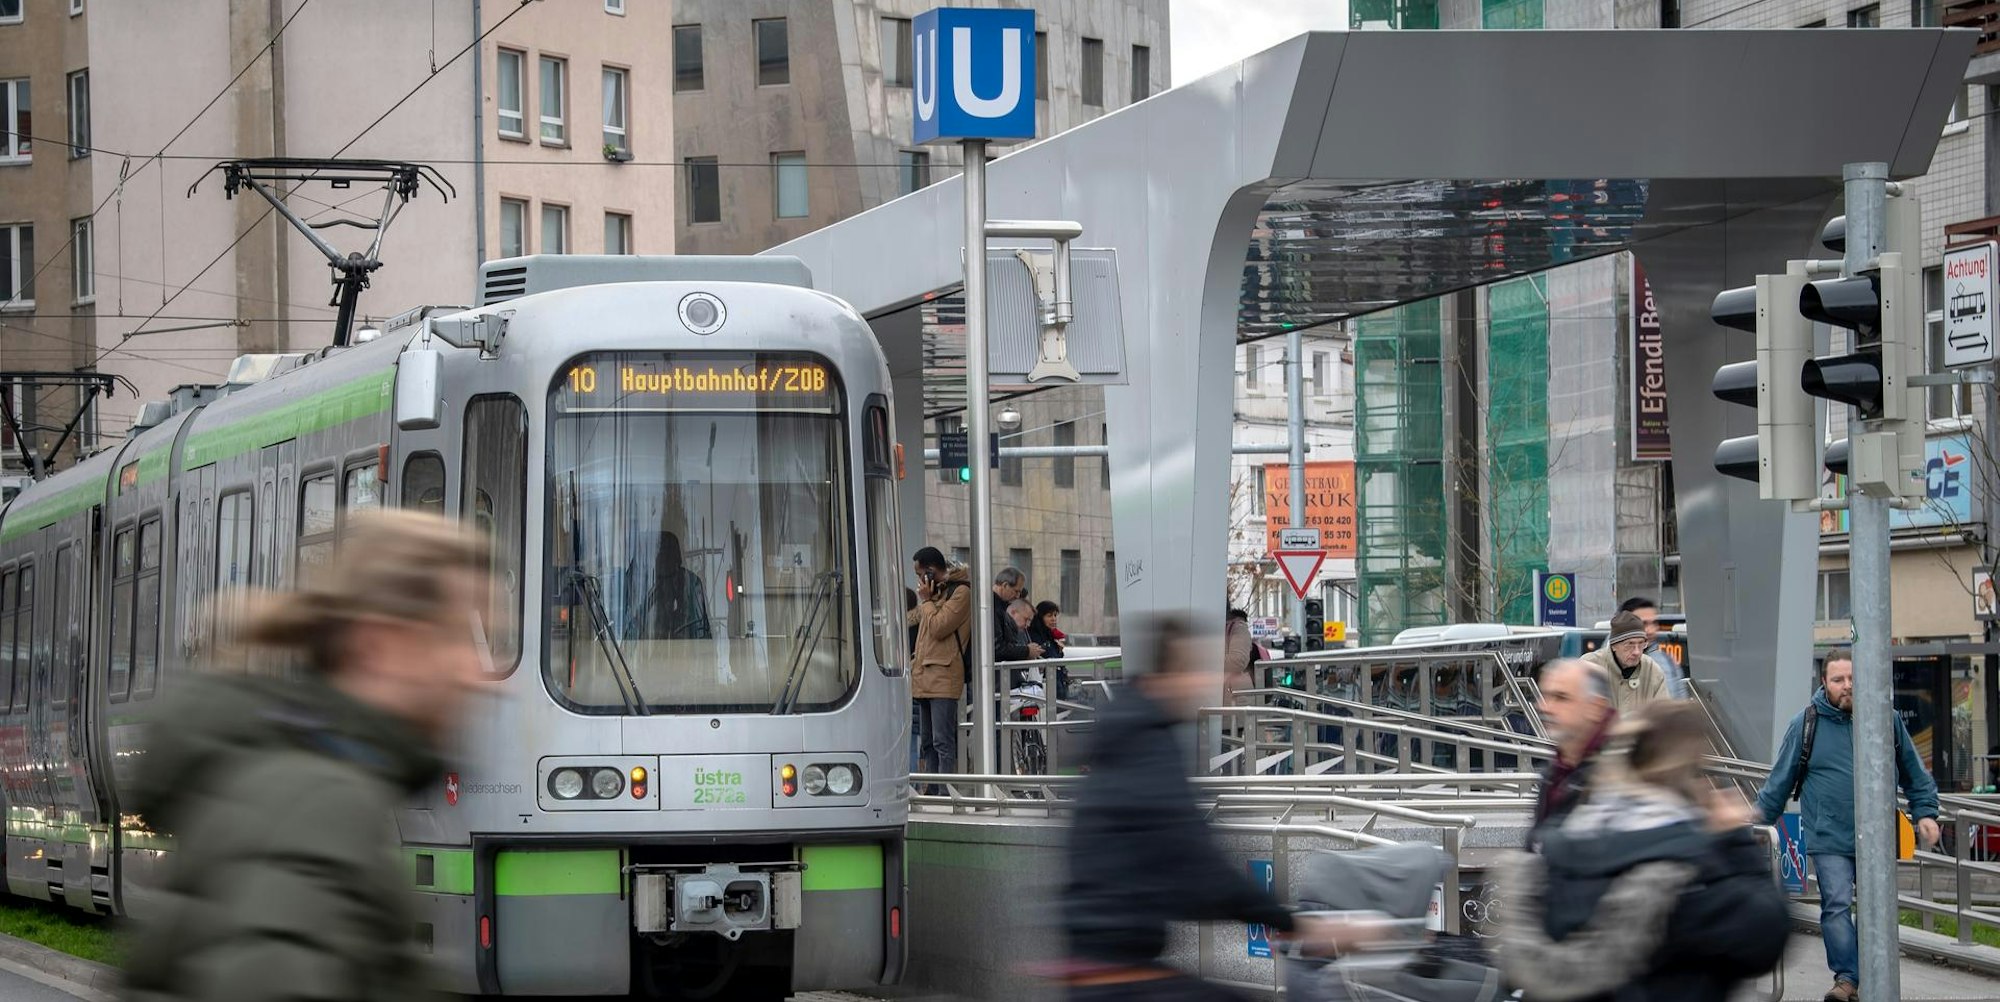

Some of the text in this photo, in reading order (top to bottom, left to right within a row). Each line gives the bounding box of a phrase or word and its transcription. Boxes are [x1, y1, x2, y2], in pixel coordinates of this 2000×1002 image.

[917, 28, 936, 121] U
[952, 27, 1021, 118] U
[1946, 252, 1988, 280] Achtung!
[569, 367, 825, 394] 10 Hauptbahnhof/ZOB
[1639, 334, 1667, 413] Efendi
[1275, 477, 1339, 490] GESTBAU
[1311, 516, 1322, 525] 63
[1324, 516, 1334, 525] 02
[1336, 516, 1352, 525] 420
[1324, 530, 1334, 539] 55
[1336, 530, 1352, 539] 370
[694, 767, 742, 786] üstra
[693, 787, 746, 804] 2572a
